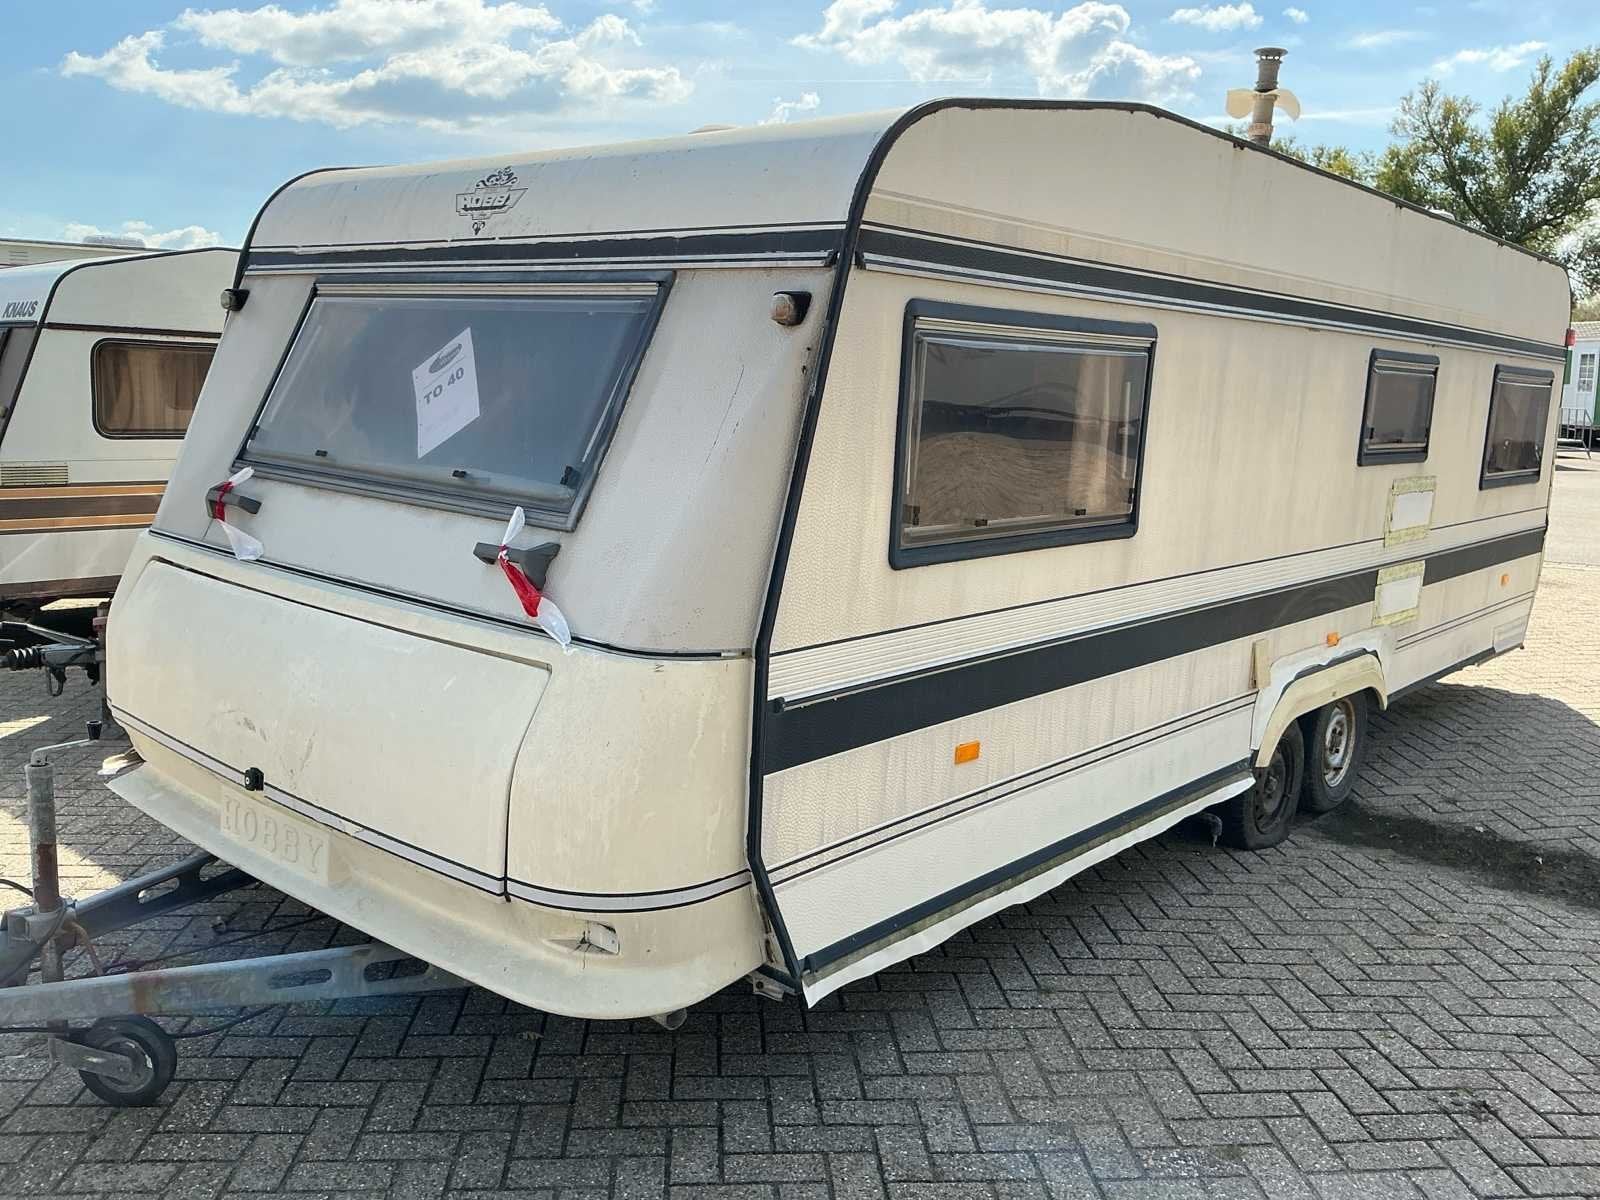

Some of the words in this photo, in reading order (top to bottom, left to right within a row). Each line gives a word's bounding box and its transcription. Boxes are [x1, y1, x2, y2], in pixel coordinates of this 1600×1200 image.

[2, 300, 38, 318] KNAUS
[423, 384, 443, 404] TO
[447, 367, 465, 386] 40
[223, 796, 324, 874] HOBBY
